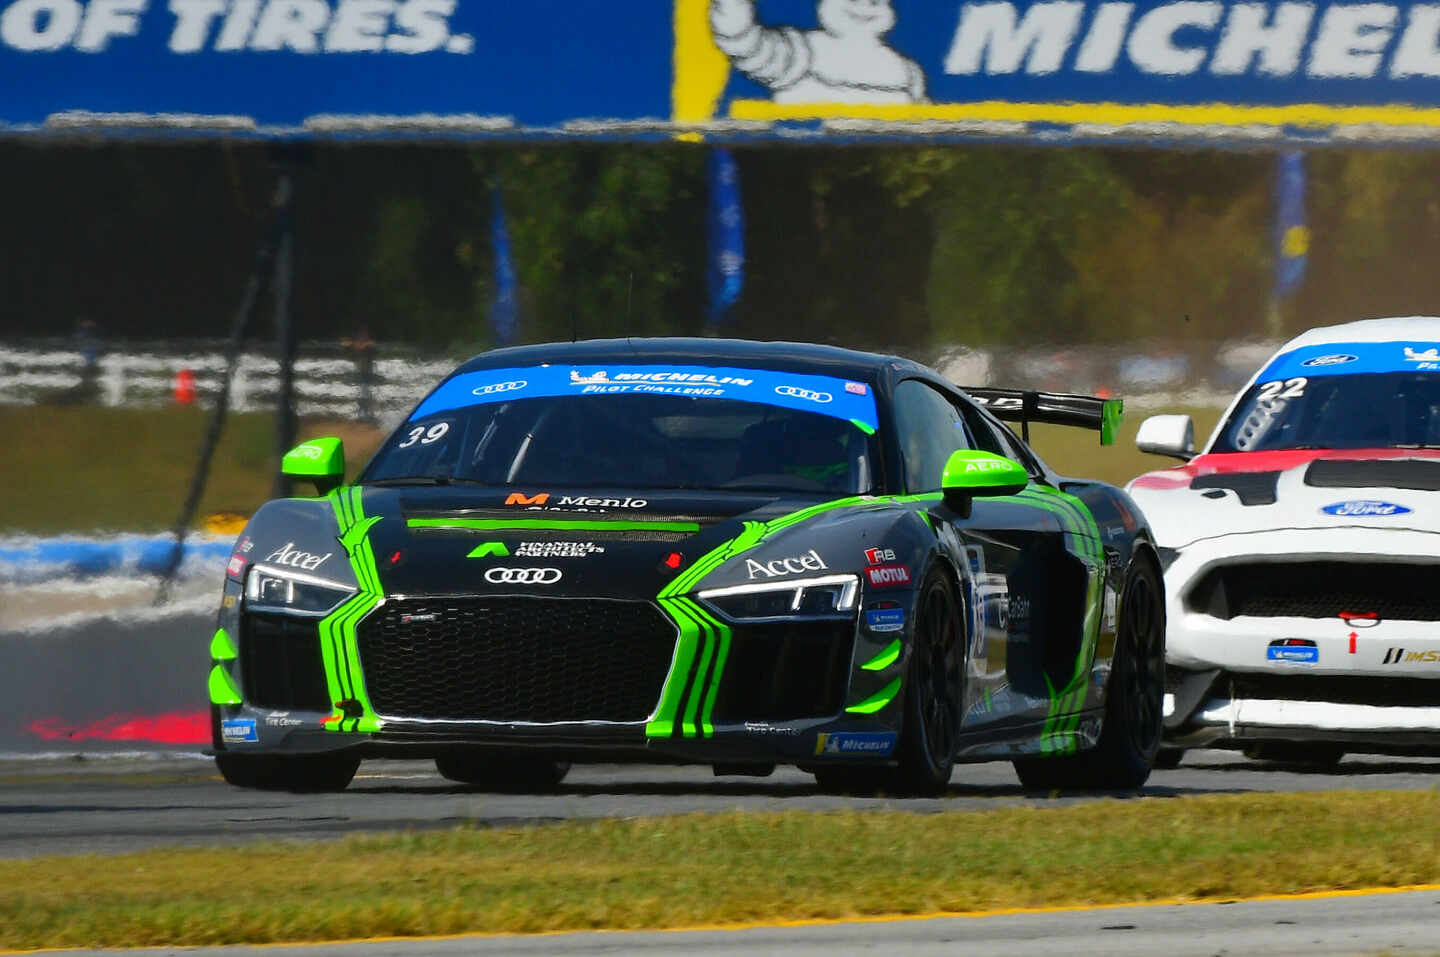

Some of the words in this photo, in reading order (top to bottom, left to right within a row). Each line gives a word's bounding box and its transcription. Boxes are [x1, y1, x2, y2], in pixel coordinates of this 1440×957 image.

[614, 373, 753, 386] MICHELIN
[582, 385, 630, 394] PILOT
[633, 385, 725, 395] CHALLENGE
[1257, 377, 1308, 401] 22
[399, 422, 449, 448] 39
[965, 461, 1013, 474] AERO
[558, 496, 648, 508] Menlo
[1335, 501, 1396, 515] Ford
[264, 542, 333, 571] Accel
[873, 548, 896, 562] R8
[744, 549, 829, 580] Accel
[869, 568, 909, 584] MOTUL
[842, 739, 891, 750] MICHELIN
